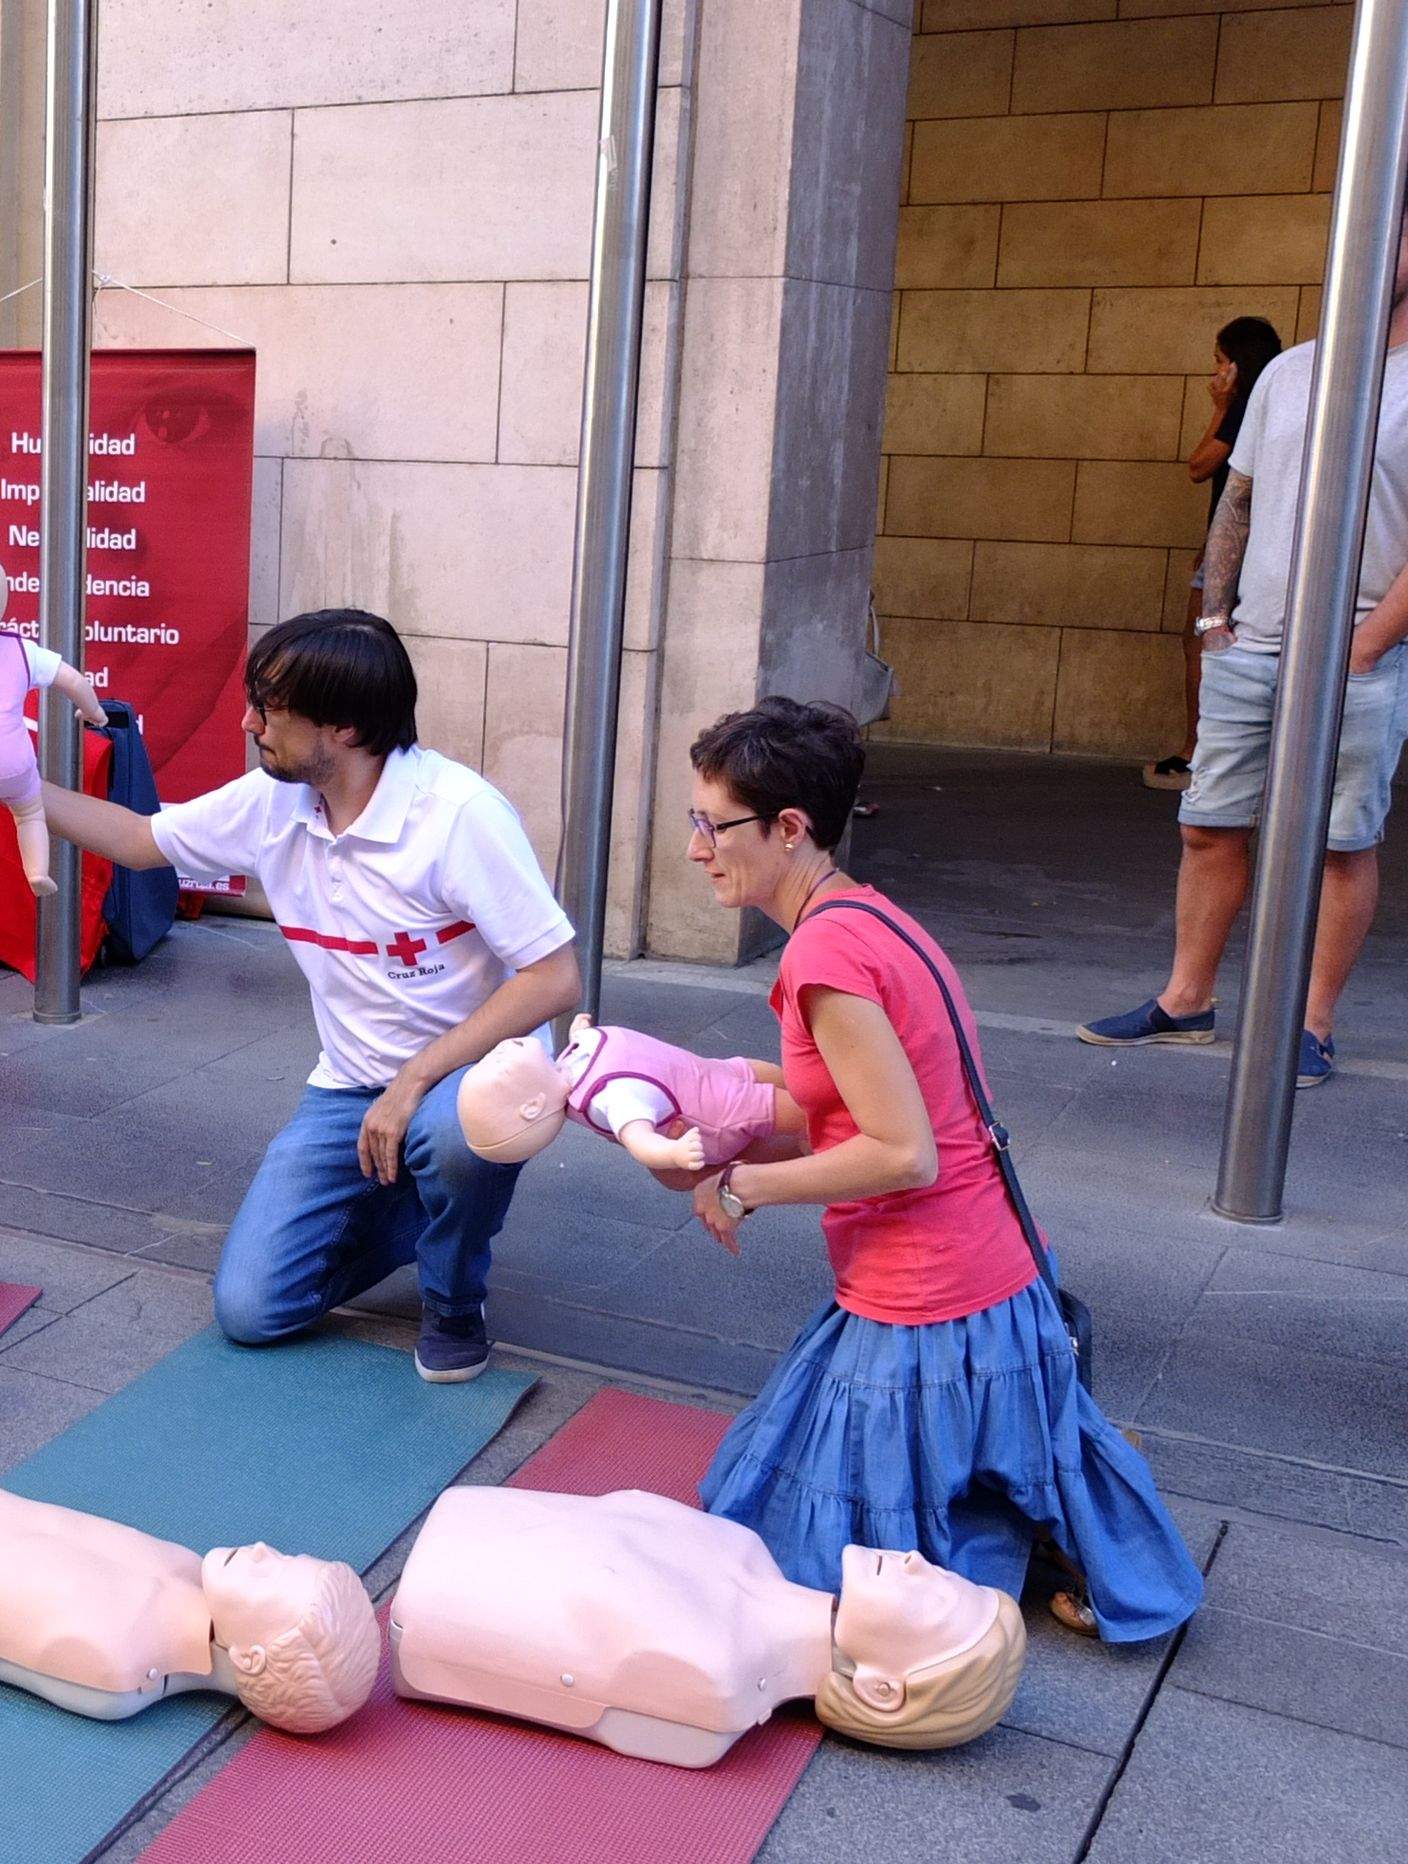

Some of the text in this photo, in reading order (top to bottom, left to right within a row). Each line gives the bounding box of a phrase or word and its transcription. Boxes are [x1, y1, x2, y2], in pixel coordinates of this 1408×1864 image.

[11, 432, 135, 455] Huidad
[0, 478, 145, 506] Impalidad
[9, 525, 136, 550] Nelidad
[85, 620, 180, 645] oluntario
[387, 964, 445, 980] Cruz Roja
